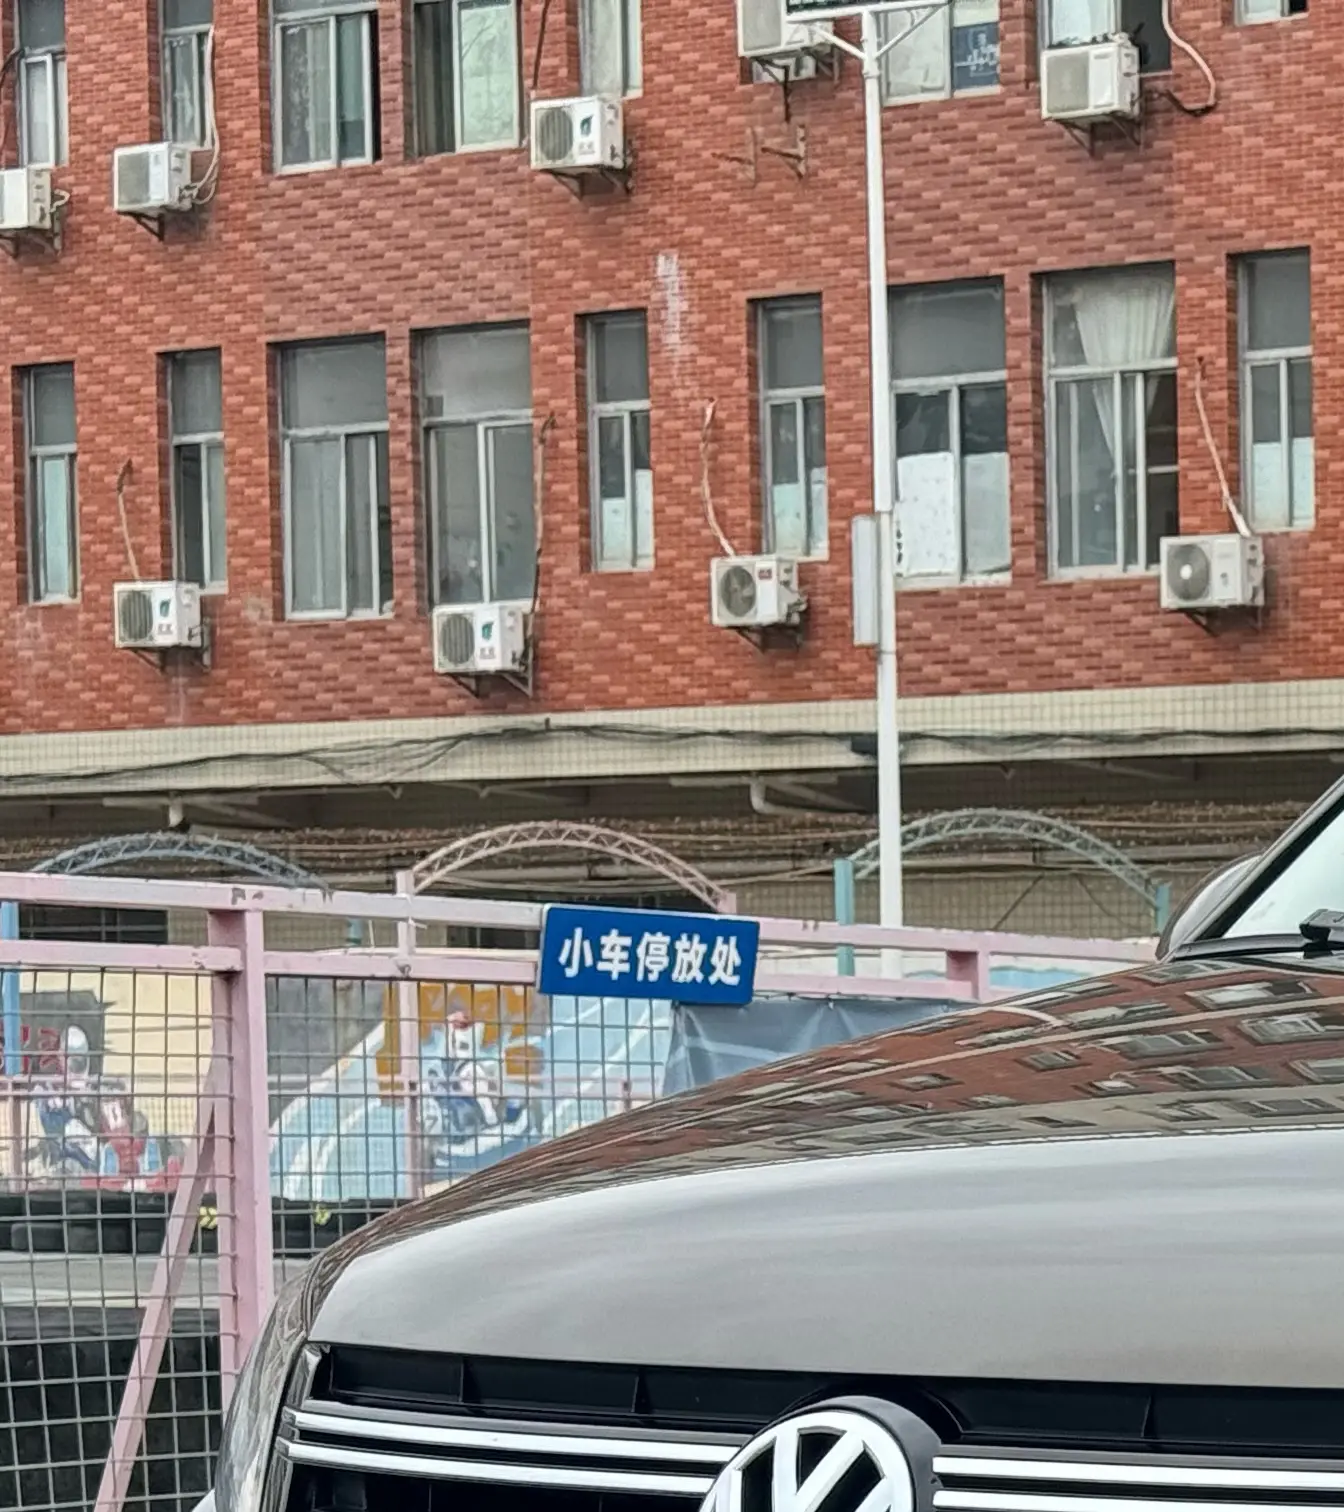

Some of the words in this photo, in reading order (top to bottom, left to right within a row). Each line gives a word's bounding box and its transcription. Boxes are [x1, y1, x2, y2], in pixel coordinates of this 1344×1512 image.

[558, 927, 742, 986] 小车停放处
